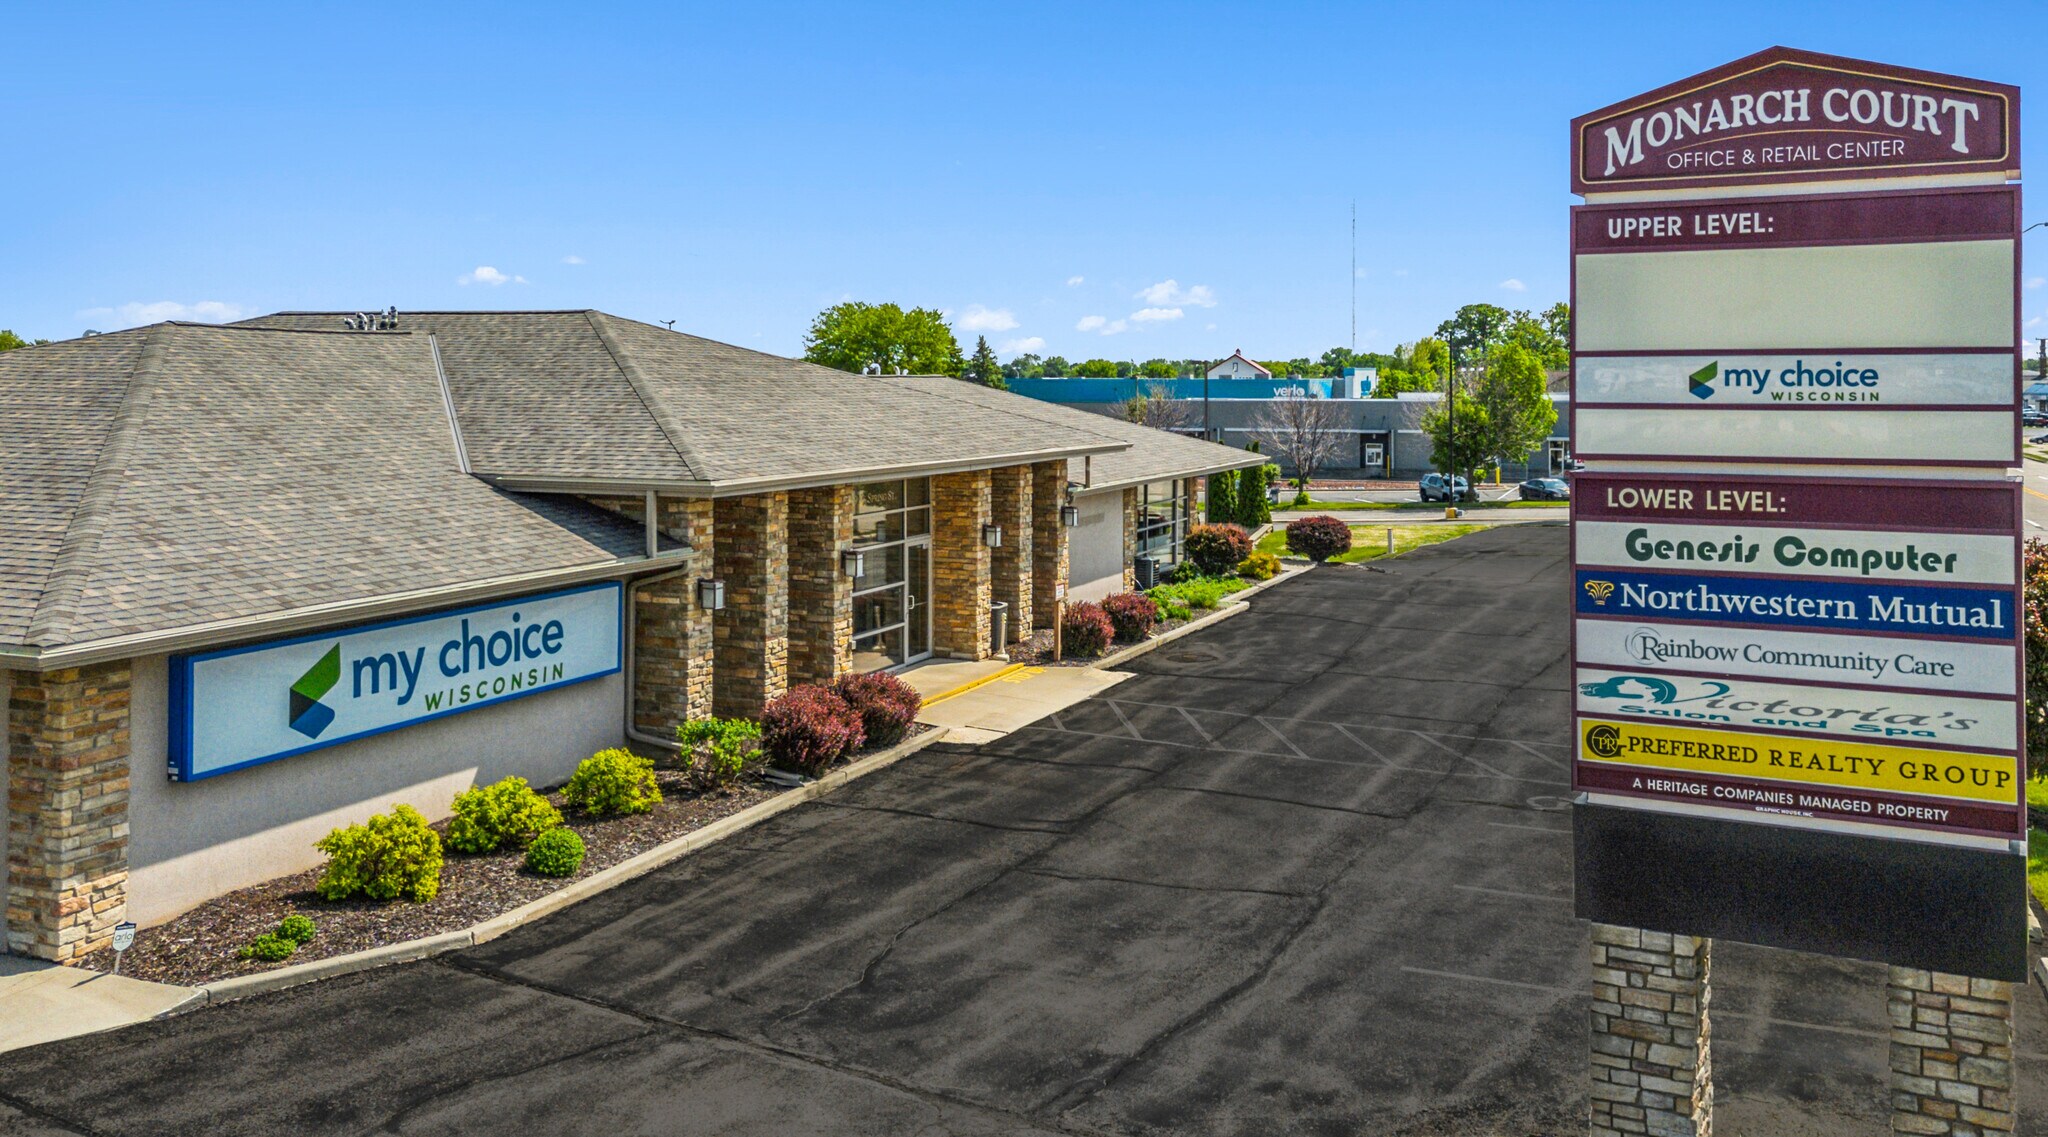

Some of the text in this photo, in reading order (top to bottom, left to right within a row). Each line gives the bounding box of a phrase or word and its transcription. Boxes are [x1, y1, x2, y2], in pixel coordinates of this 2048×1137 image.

[1603, 87, 1980, 177] MONARCH COURT
[1667, 139, 1905, 170] OFFICE & RETAIL CENTER
[1607, 212, 1775, 239] UPPER LEVEL:
[1273, 384, 1306, 397] verlo
[1724, 360, 1880, 395] my choice
[1771, 391, 1880, 402] WISCONSIN
[1607, 487, 1787, 514] LOWER LEVEL:
[1624, 528, 1958, 576] Genesis Computer
[1620, 582, 2005, 630] Northwestern Mutual
[353, 612, 565, 706] my choice
[1640, 635, 1955, 679] Rainbow Community Care
[424, 662, 564, 712] WISCONSIN
[1640, 677, 1979, 730] Victoria's
[1618, 704, 1938, 737] Salon and Spa
[1628, 735, 1758, 764] PREFERRED
[1769, 748, 1885, 777] REALTY
[1899, 760, 2012, 789] GROUP
[1633, 777, 1950, 822] A HERITAGE COMPANIES MANAGED PROPERTY
[1755, 806, 1780, 814] GRAPHIC
